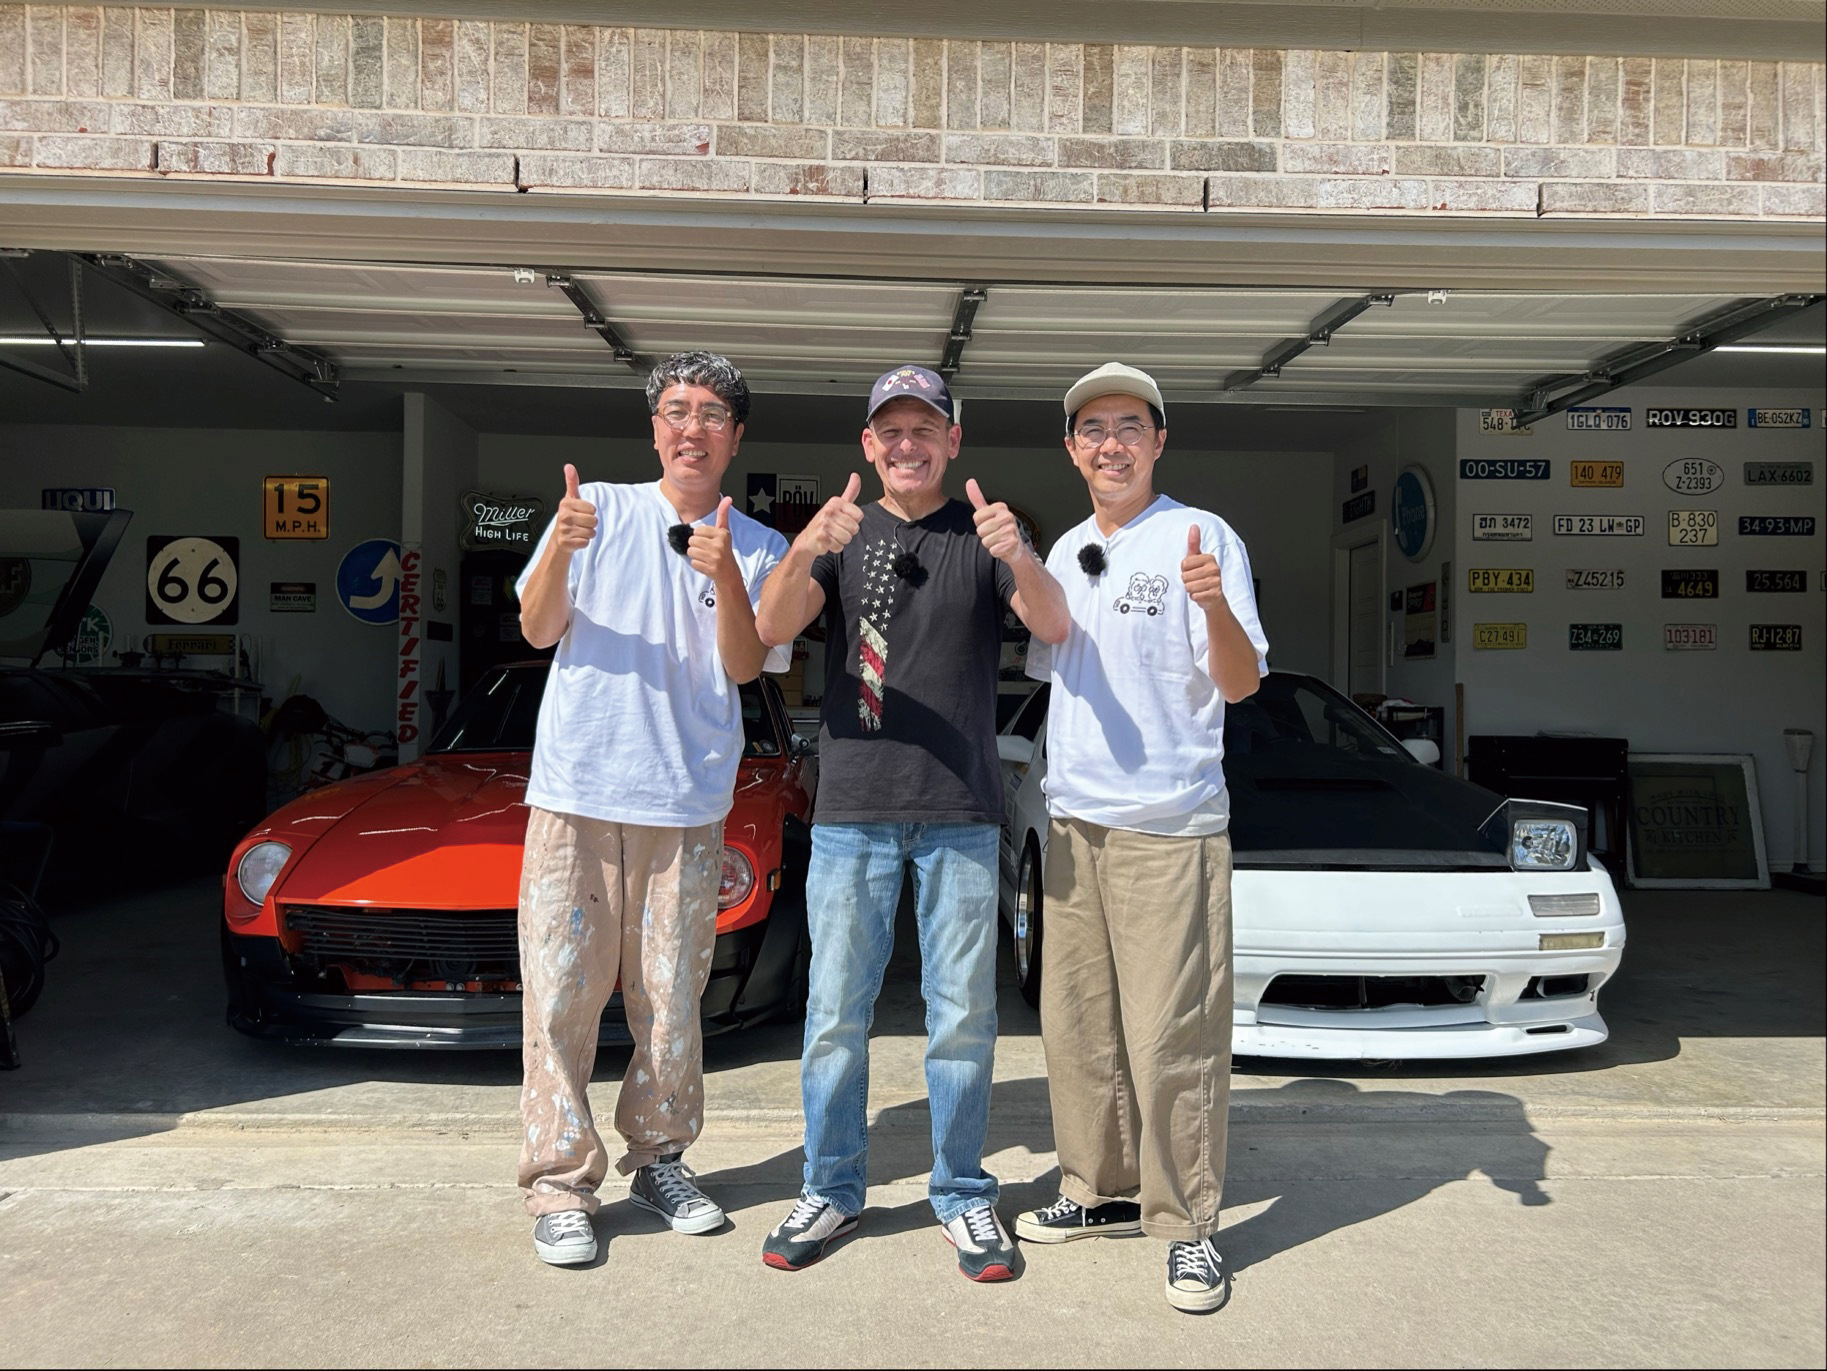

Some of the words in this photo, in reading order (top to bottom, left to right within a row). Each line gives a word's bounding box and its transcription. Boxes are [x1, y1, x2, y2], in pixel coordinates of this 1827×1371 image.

[1649, 410, 1684, 425] ROV
[1689, 411, 1735, 426] 930G
[1574, 466, 1594, 480] 140
[1601, 466, 1622, 480] 479
[1684, 463, 1703, 475] 651
[45, 491, 111, 511] LIQUI
[274, 484, 321, 514] 15
[474, 503, 536, 526] Miller
[275, 520, 321, 533] M.P.H.
[1502, 517, 1530, 528] 3472
[1558, 518, 1573, 532] FD
[1579, 518, 1594, 532] 23
[1600, 519, 1615, 532] LW
[1625, 519, 1641, 532] GP
[475, 526, 501, 539] HIGH
[505, 529, 530, 542] LIFE
[1679, 529, 1708, 543] 237
[157, 557, 229, 604] 66
[1677, 581, 1713, 597] 4649
[167, 638, 216, 650] Ferrari
[1637, 806, 1740, 826] COUNTRY
[1662, 830, 1721, 844] KITCHEN
